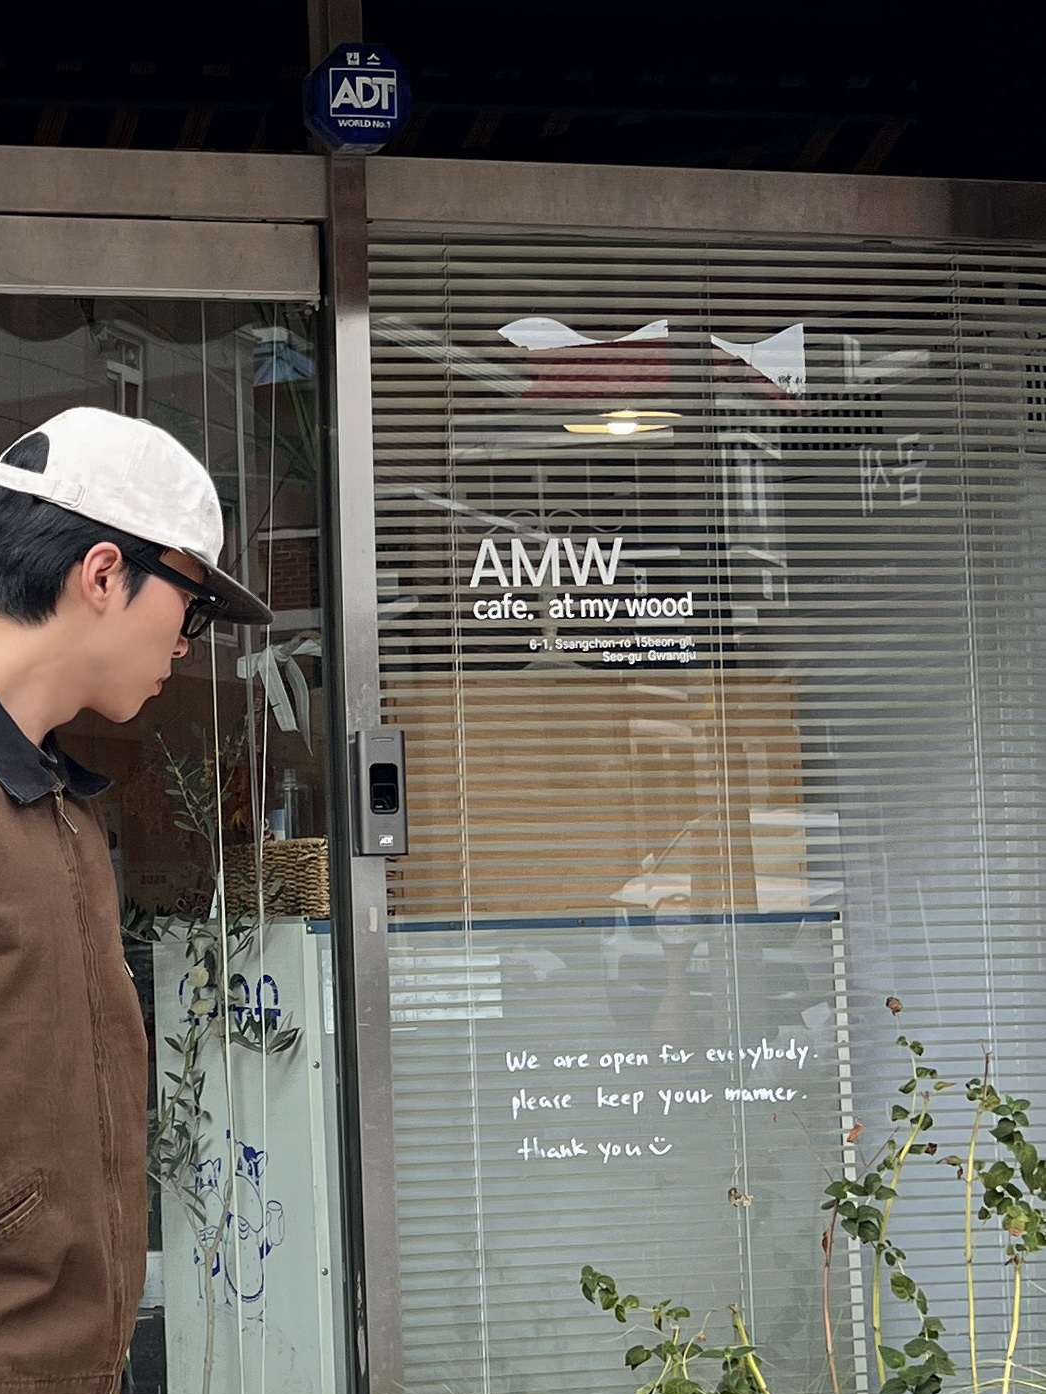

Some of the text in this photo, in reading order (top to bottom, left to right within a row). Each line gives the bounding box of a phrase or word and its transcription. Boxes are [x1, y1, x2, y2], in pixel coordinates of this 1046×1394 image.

[331, 77, 395, 110] ADT
[338, 119, 391, 129] WORLD No.1
[469, 537, 623, 588] AMW
[473, 591, 694, 622] cafe. at my wood
[648, 649, 697, 663] Gwangju
[506, 1051, 540, 1073] We
[553, 1055, 590, 1068] are
[600, 1053, 648, 1074] open
[659, 1044, 695, 1064] for
[511, 1087, 573, 1120] please
[597, 1086, 645, 1115] keep
[658, 1088, 713, 1116] your
[517, 1137, 642, 1163] thank you
